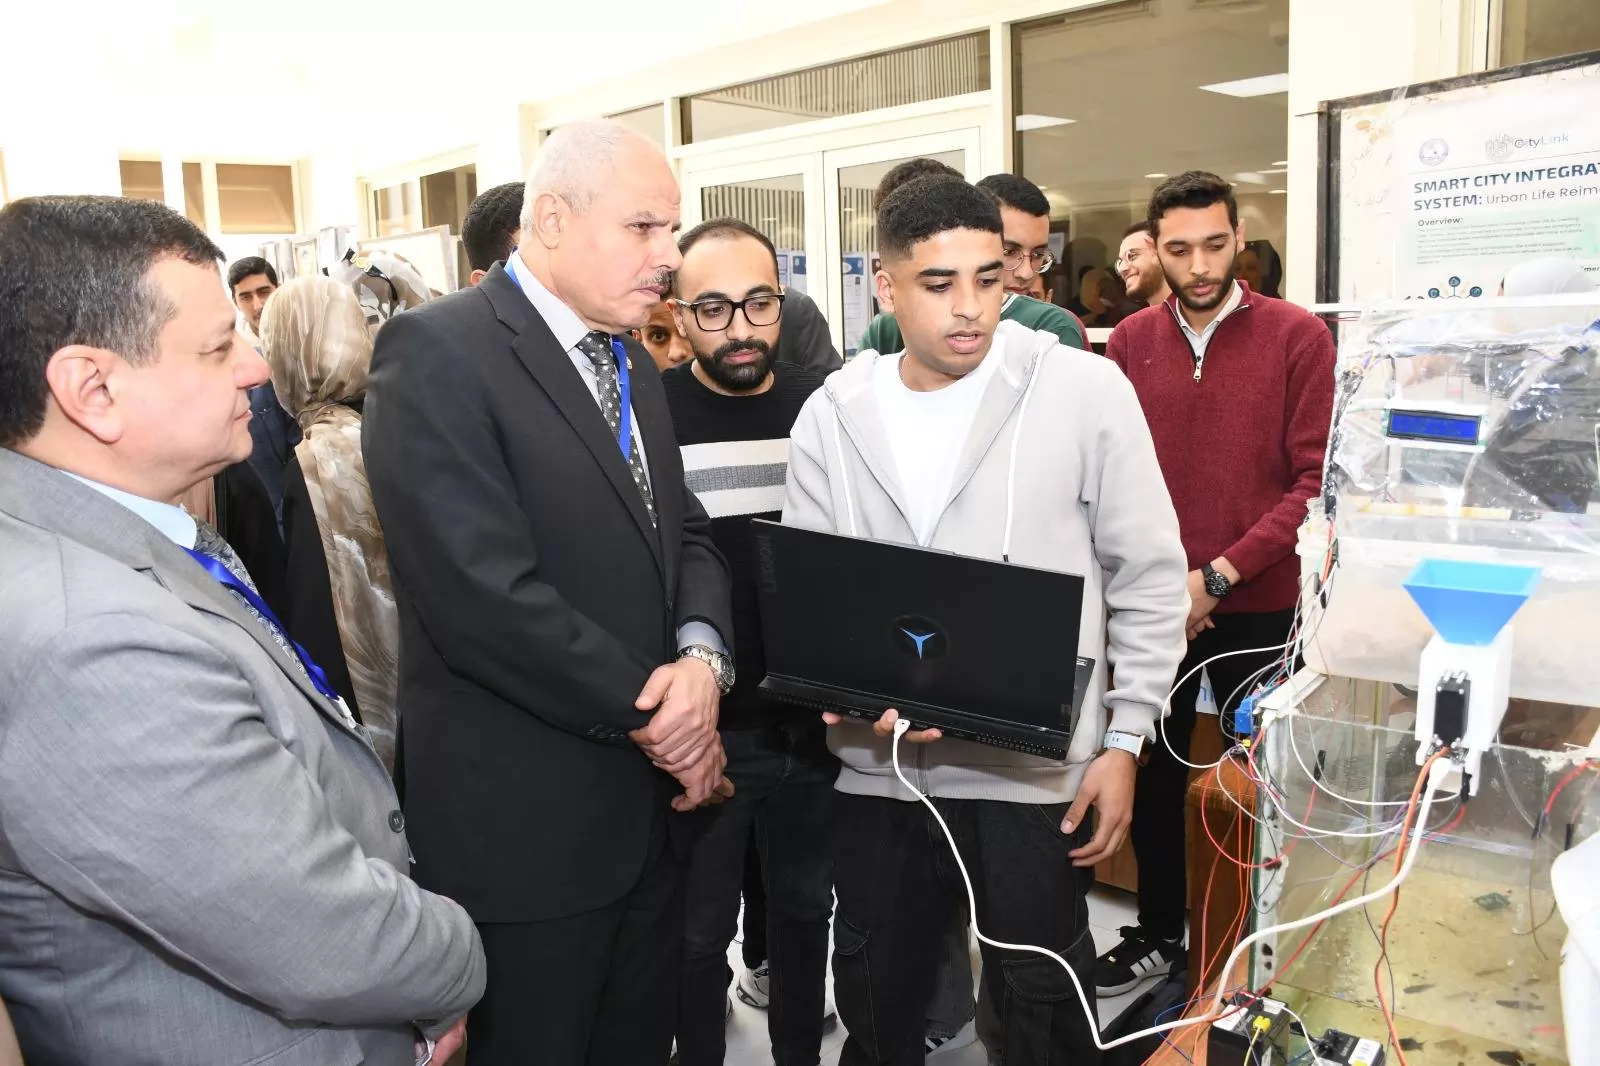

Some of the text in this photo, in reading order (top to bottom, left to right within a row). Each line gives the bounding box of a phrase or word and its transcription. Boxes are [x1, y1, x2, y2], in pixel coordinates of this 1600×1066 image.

[1414, 177, 1470, 194] SMART
[1473, 172, 1511, 188] CITY
[1414, 185, 1600, 211] SYSTEM: Urban Life Reim
[1417, 217, 1464, 227] Overview:
